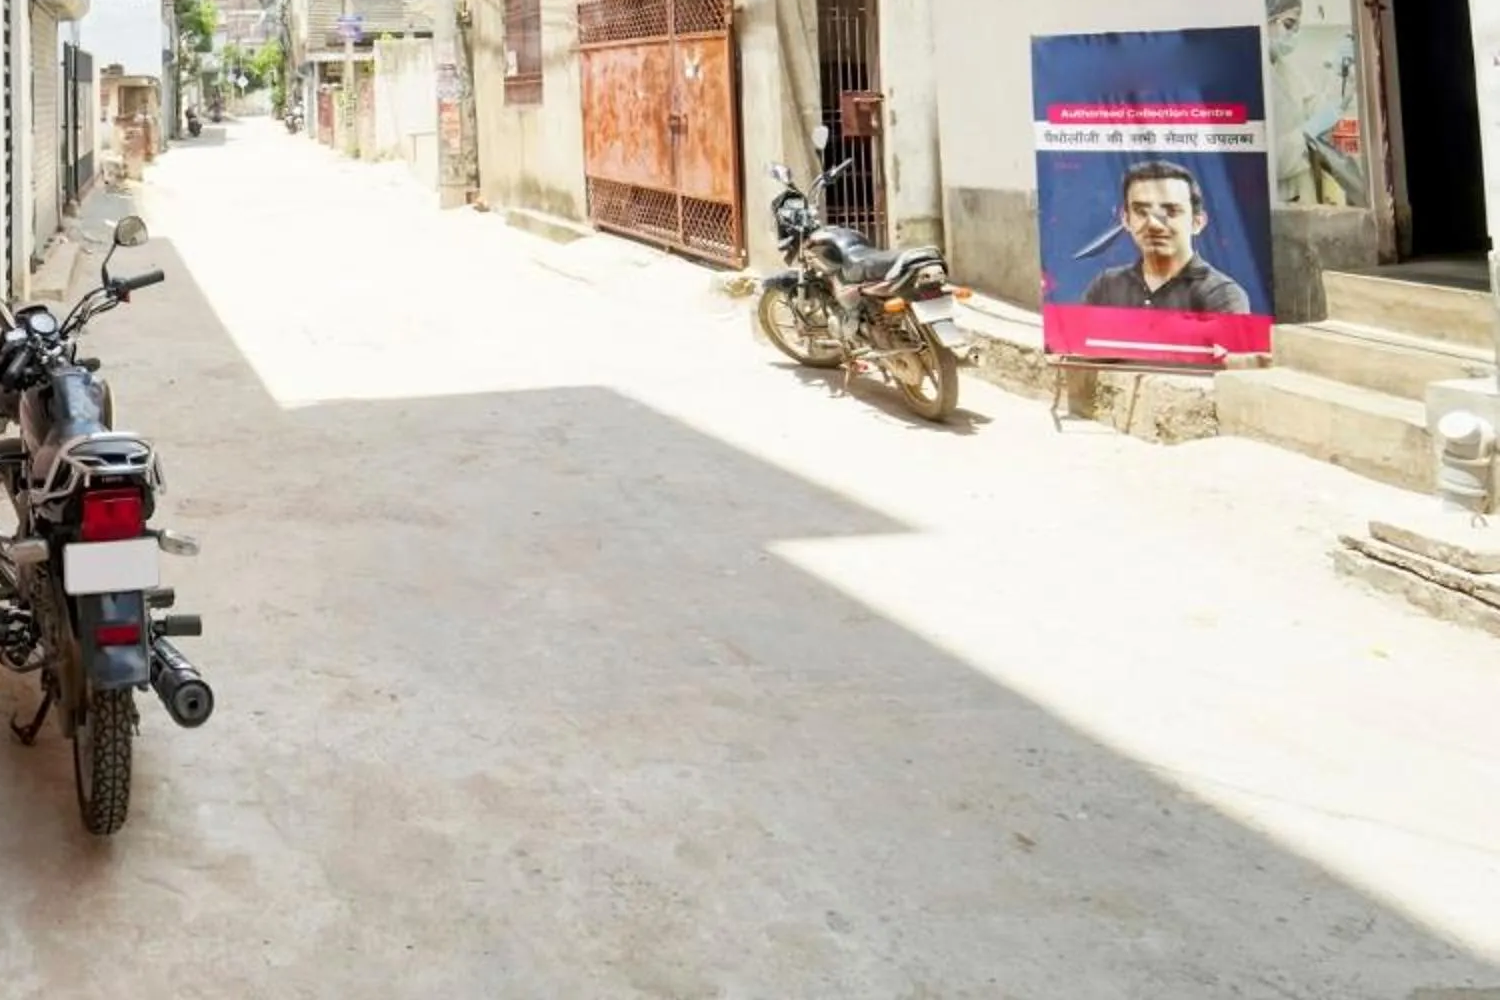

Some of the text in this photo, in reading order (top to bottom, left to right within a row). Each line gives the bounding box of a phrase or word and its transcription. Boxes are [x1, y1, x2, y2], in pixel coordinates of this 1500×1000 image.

[1126, 107, 1189, 119] Collection
[1190, 107, 1233, 118] Centre
[1106, 130, 1123, 145] की
